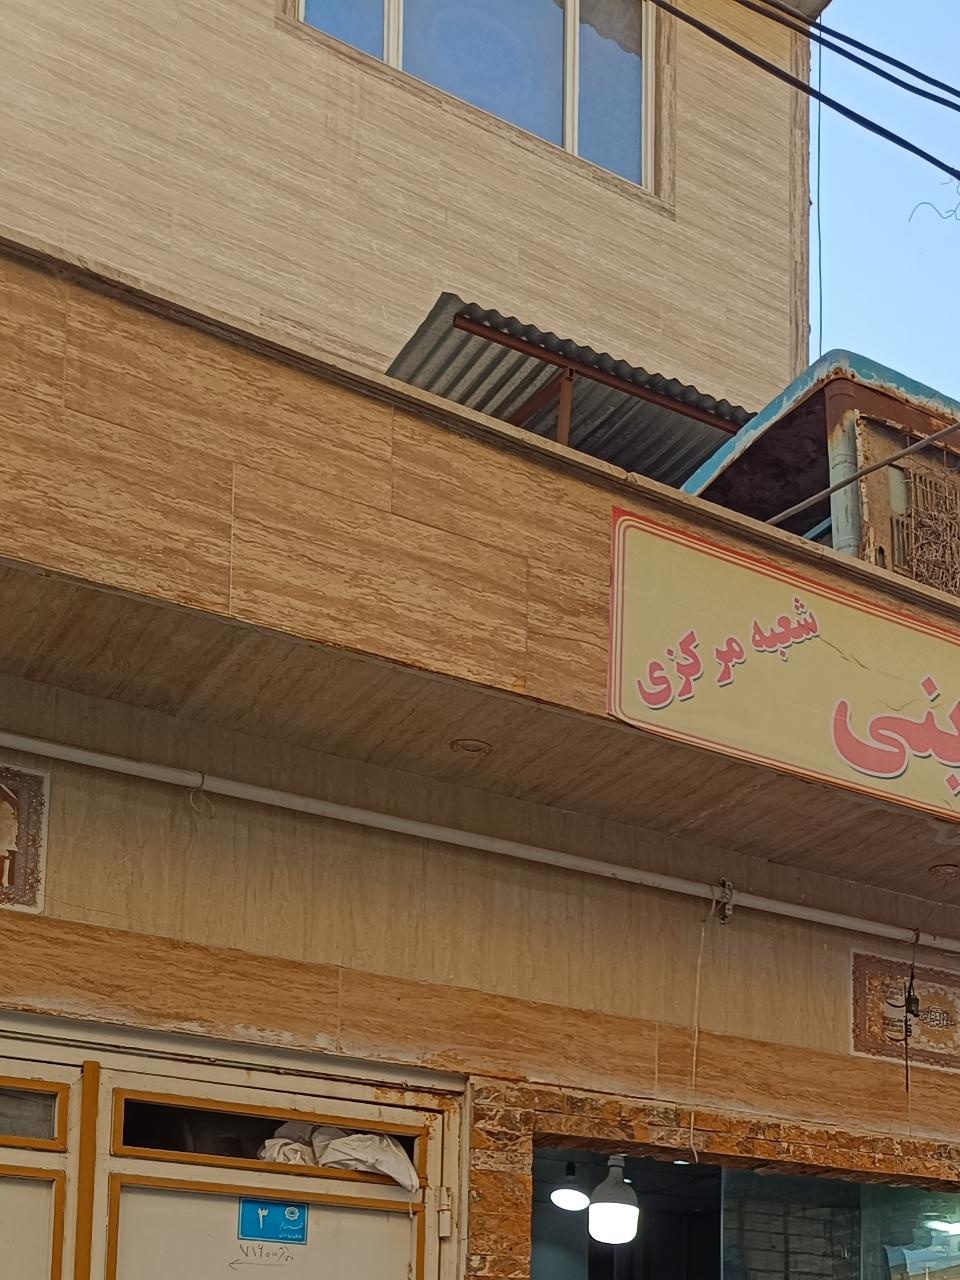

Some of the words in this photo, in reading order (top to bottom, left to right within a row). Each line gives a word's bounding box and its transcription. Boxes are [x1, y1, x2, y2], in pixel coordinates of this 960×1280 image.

[751, 597, 819, 661] شعبه
[636, 630, 746, 710] مرکزی
[257, 1207, 269, 1230] ۳
